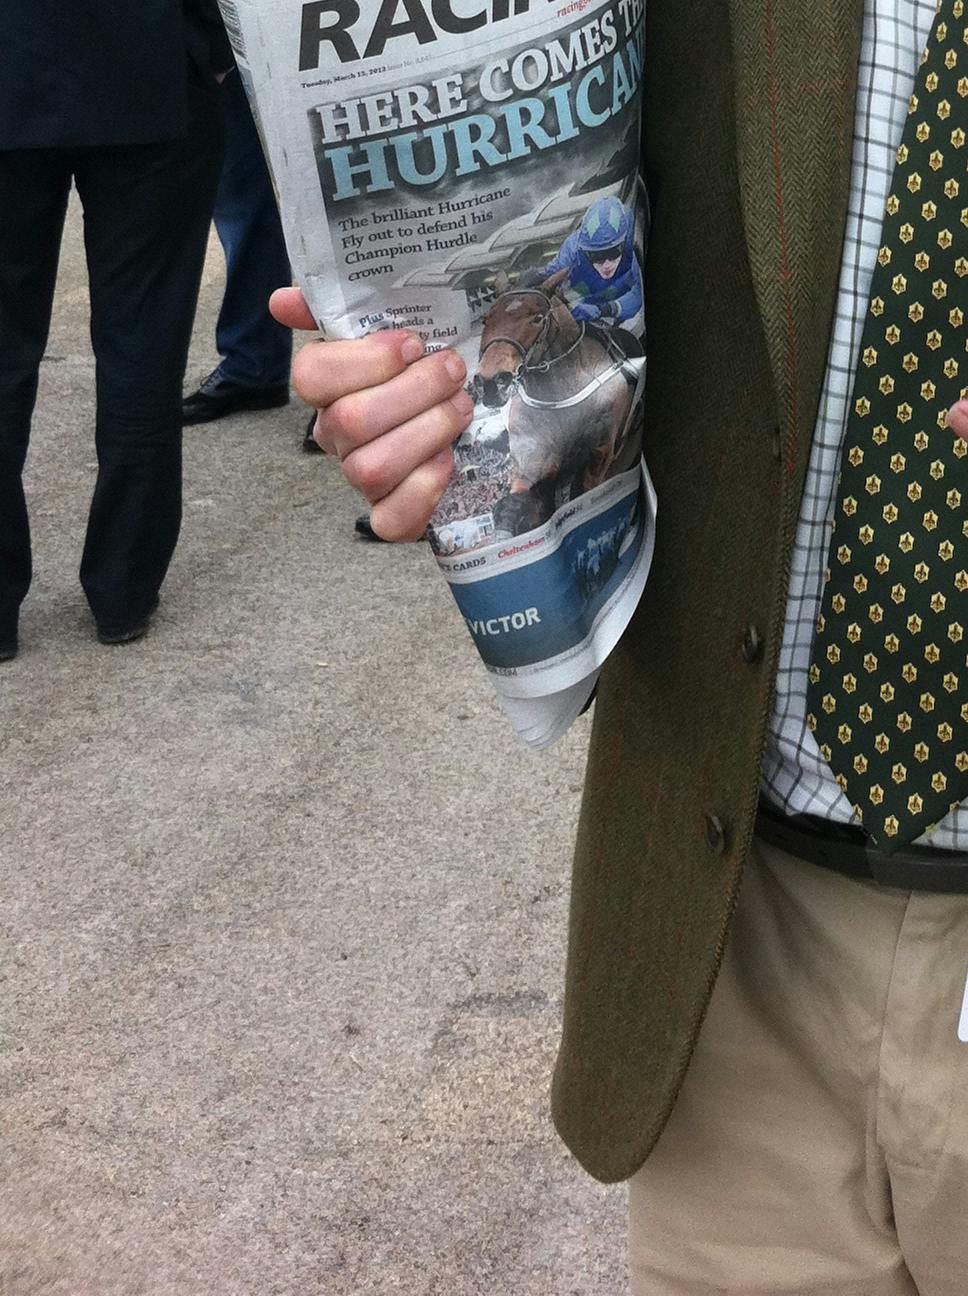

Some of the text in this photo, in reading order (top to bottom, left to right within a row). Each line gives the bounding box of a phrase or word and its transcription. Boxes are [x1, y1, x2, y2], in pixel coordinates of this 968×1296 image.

[317, 73, 467, 145] HERE
[480, 9, 617, 98] COMES
[338, 187, 512, 232] The brilliant Hurricane
[341, 210, 494, 250] Fly out to defend his
[345, 232, 478, 265] Champion Hurdle
[348, 264, 394, 282] crown
[358, 312, 384, 329] Plus
[385, 304, 432, 318] Sprinter
[433, 326, 458, 339] field
[453, 557, 487, 572] CARDS
